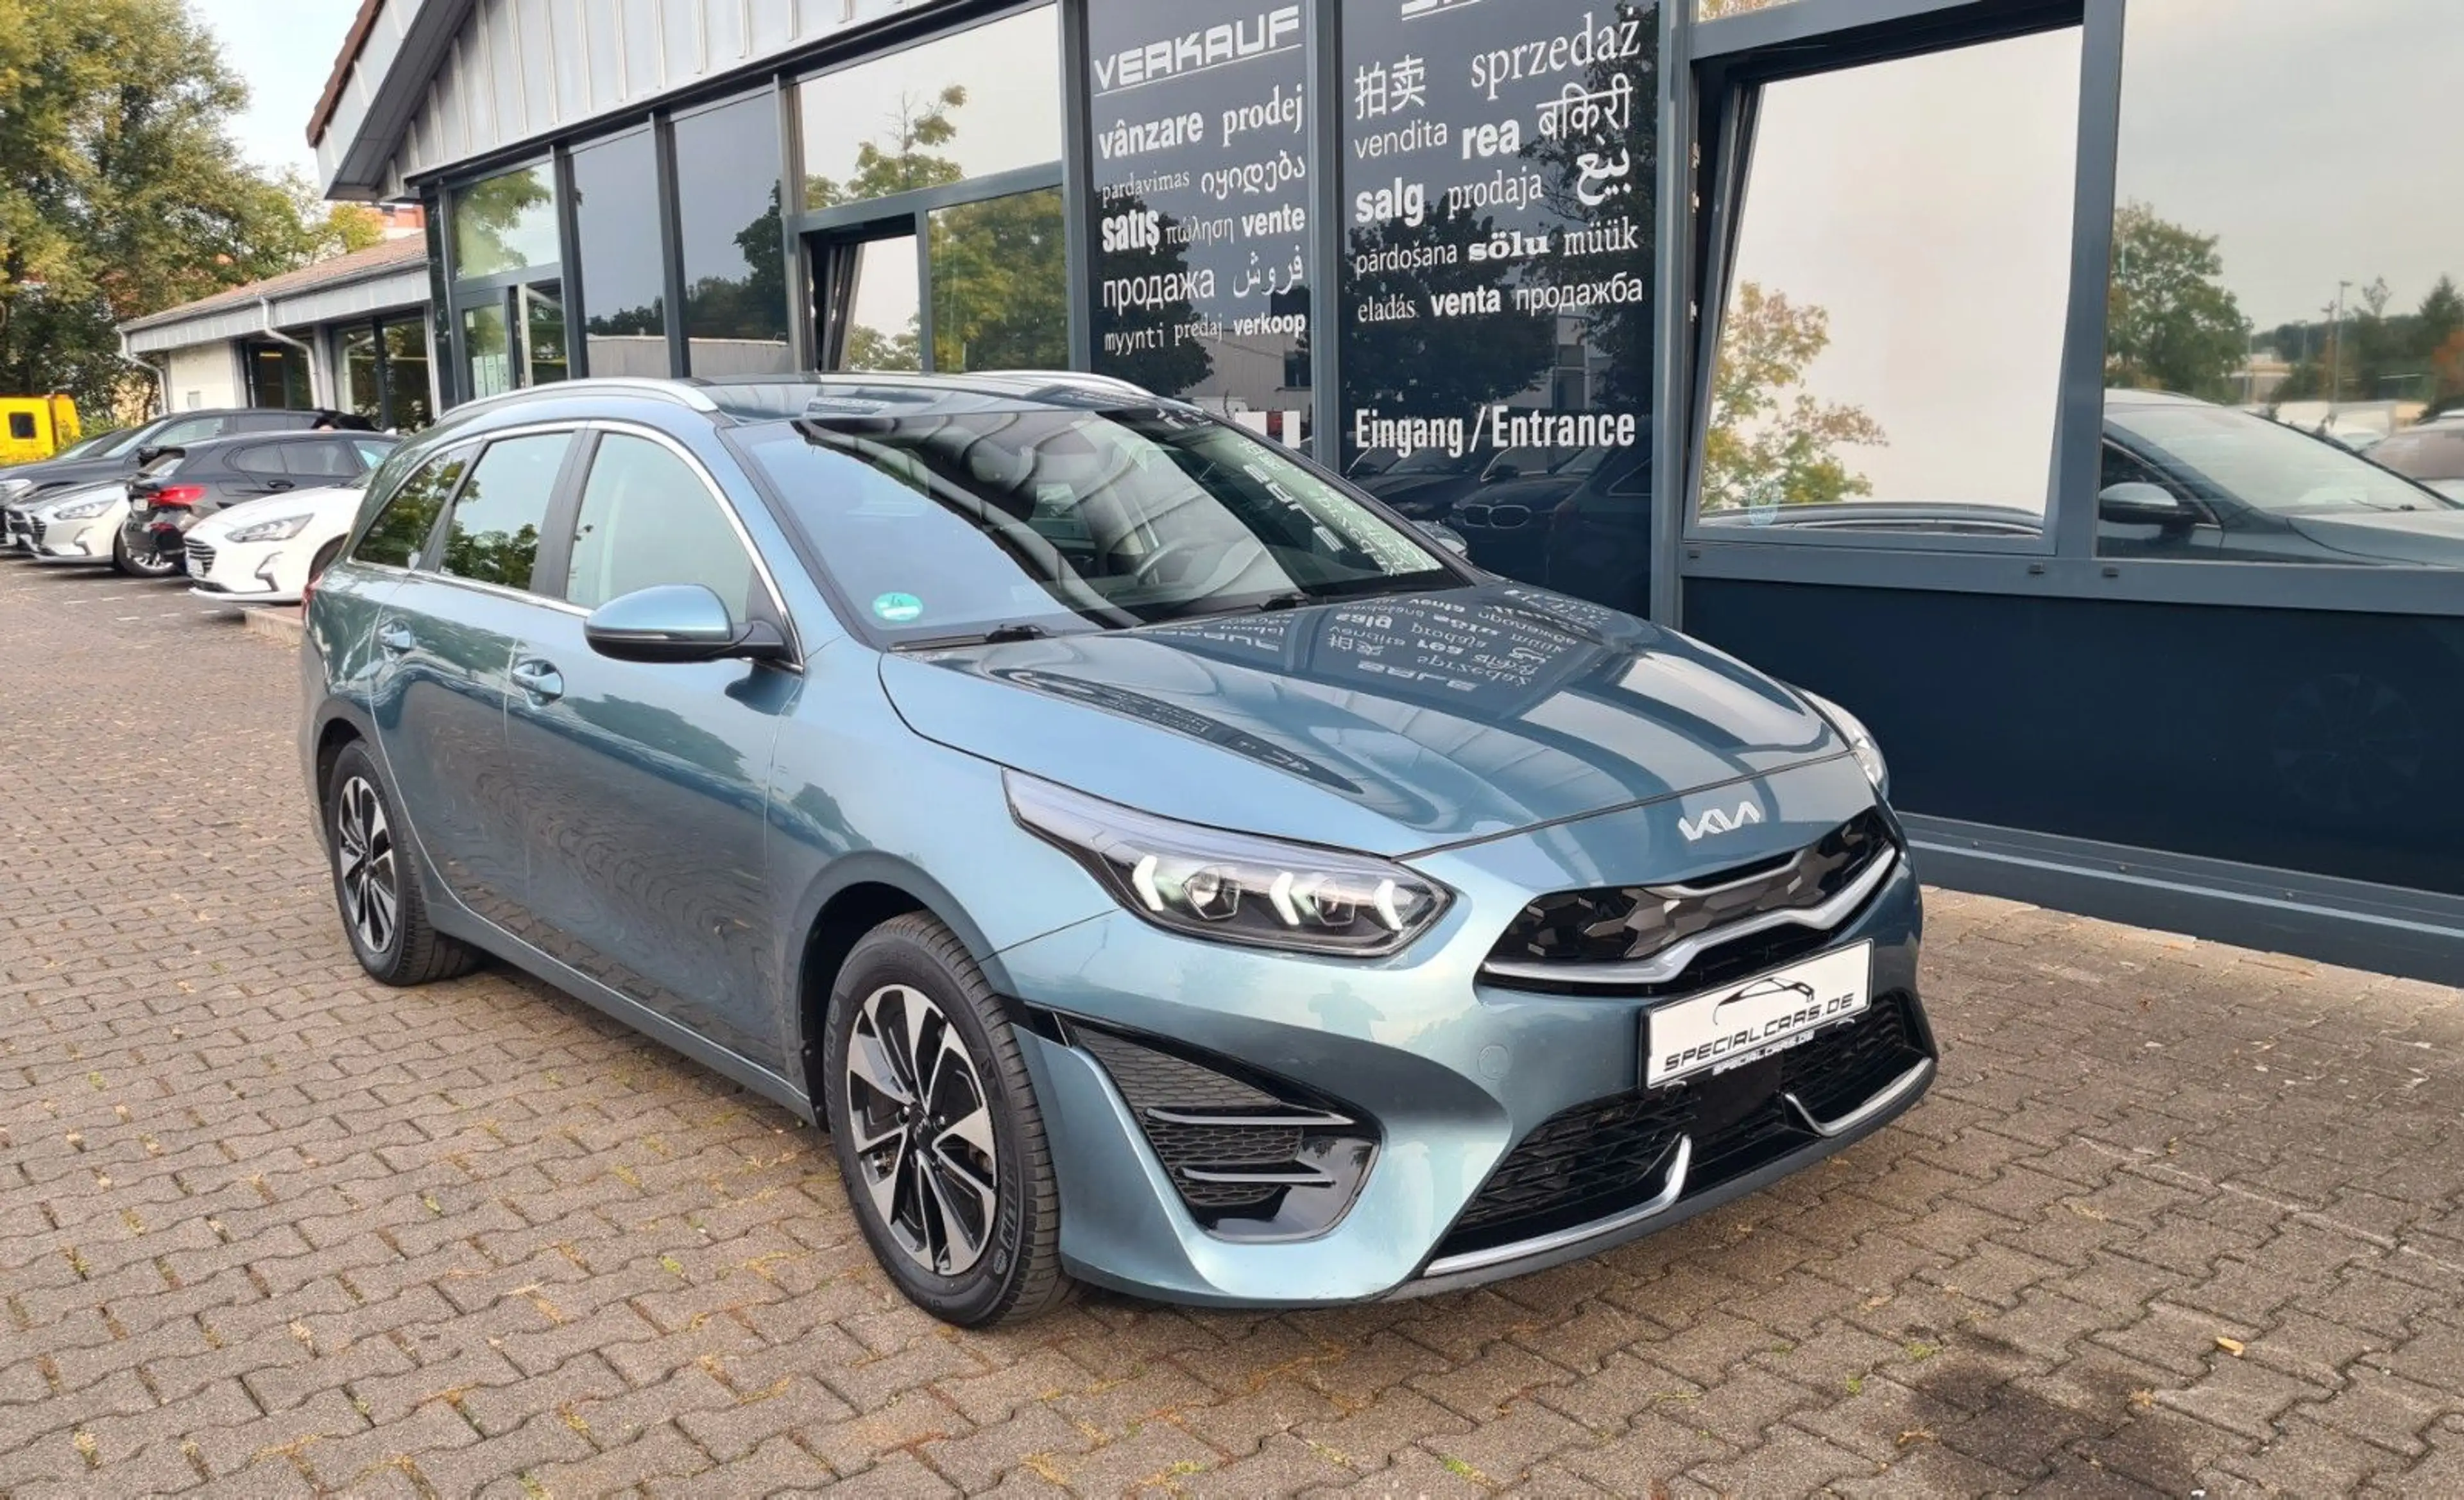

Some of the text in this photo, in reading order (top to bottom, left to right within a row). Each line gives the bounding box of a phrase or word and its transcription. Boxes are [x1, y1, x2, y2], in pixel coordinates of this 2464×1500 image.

[1093, 5, 1299, 90] VERKAUF
[1471, 7, 1640, 101] sprzedaż
[1355, 54, 1426, 121] 拍卖
[1099, 83, 1303, 160] vânzare prodej
[1354, 119, 1521, 160] vendita rea
[1102, 170, 1190, 209] pardavimas
[1355, 166, 1544, 227] salg prodaja
[1101, 209, 1160, 255] satış
[1166, 215, 1235, 246] πώληση
[1242, 203, 1306, 238] vente
[1354, 216, 1639, 281] pārdošana sölu müük
[1103, 268, 1216, 316] продажа
[1358, 284, 1502, 323] eladás venta
[1515, 272, 1643, 317] продажба
[1104, 312, 1306, 356] myynti predaj verkoop
